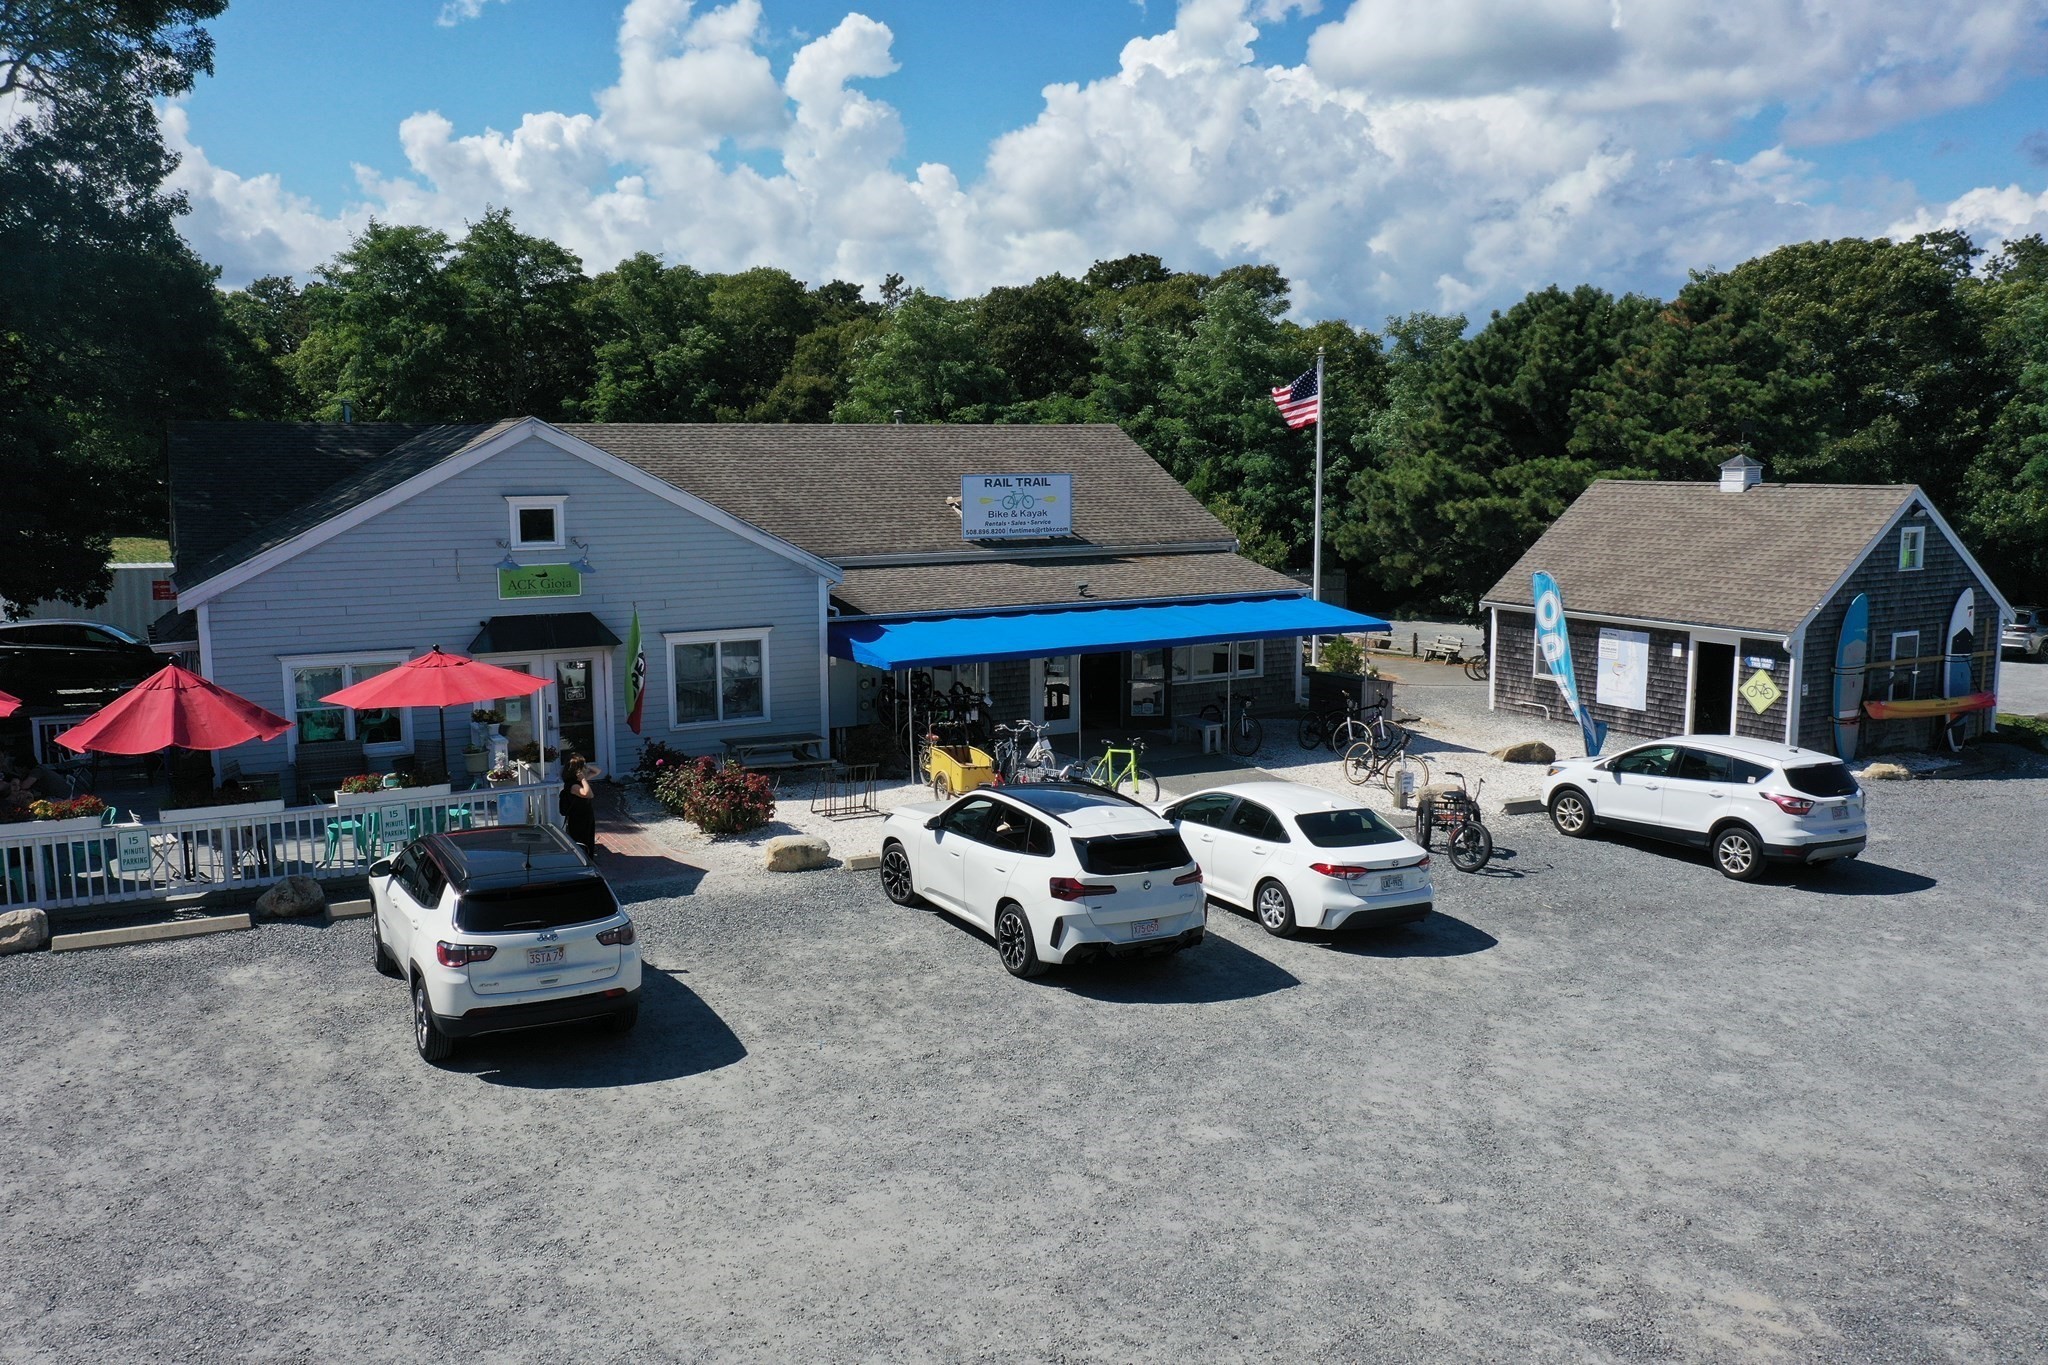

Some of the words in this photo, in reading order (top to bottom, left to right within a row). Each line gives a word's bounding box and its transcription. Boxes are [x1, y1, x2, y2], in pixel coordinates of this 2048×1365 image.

[984, 478, 1012, 487] RAIL
[1016, 477, 1051, 487] TRAIL
[988, 510, 1008, 518] Bike
[1011, 510, 1018, 518] &
[1020, 509, 1048, 519] Kayak
[1009, 527, 1069, 535] funtimes@rtbkr.com
[508, 579, 537, 591] ACK
[540, 577, 572, 589] Gioia
[389, 810, 399, 818] 15
[385, 819, 404, 828] MINUTE
[384, 828, 407, 838] PARKING
[128, 836, 139, 845] 15
[123, 846, 145, 856] MINUTE
[122, 857, 148, 866] PARKING
